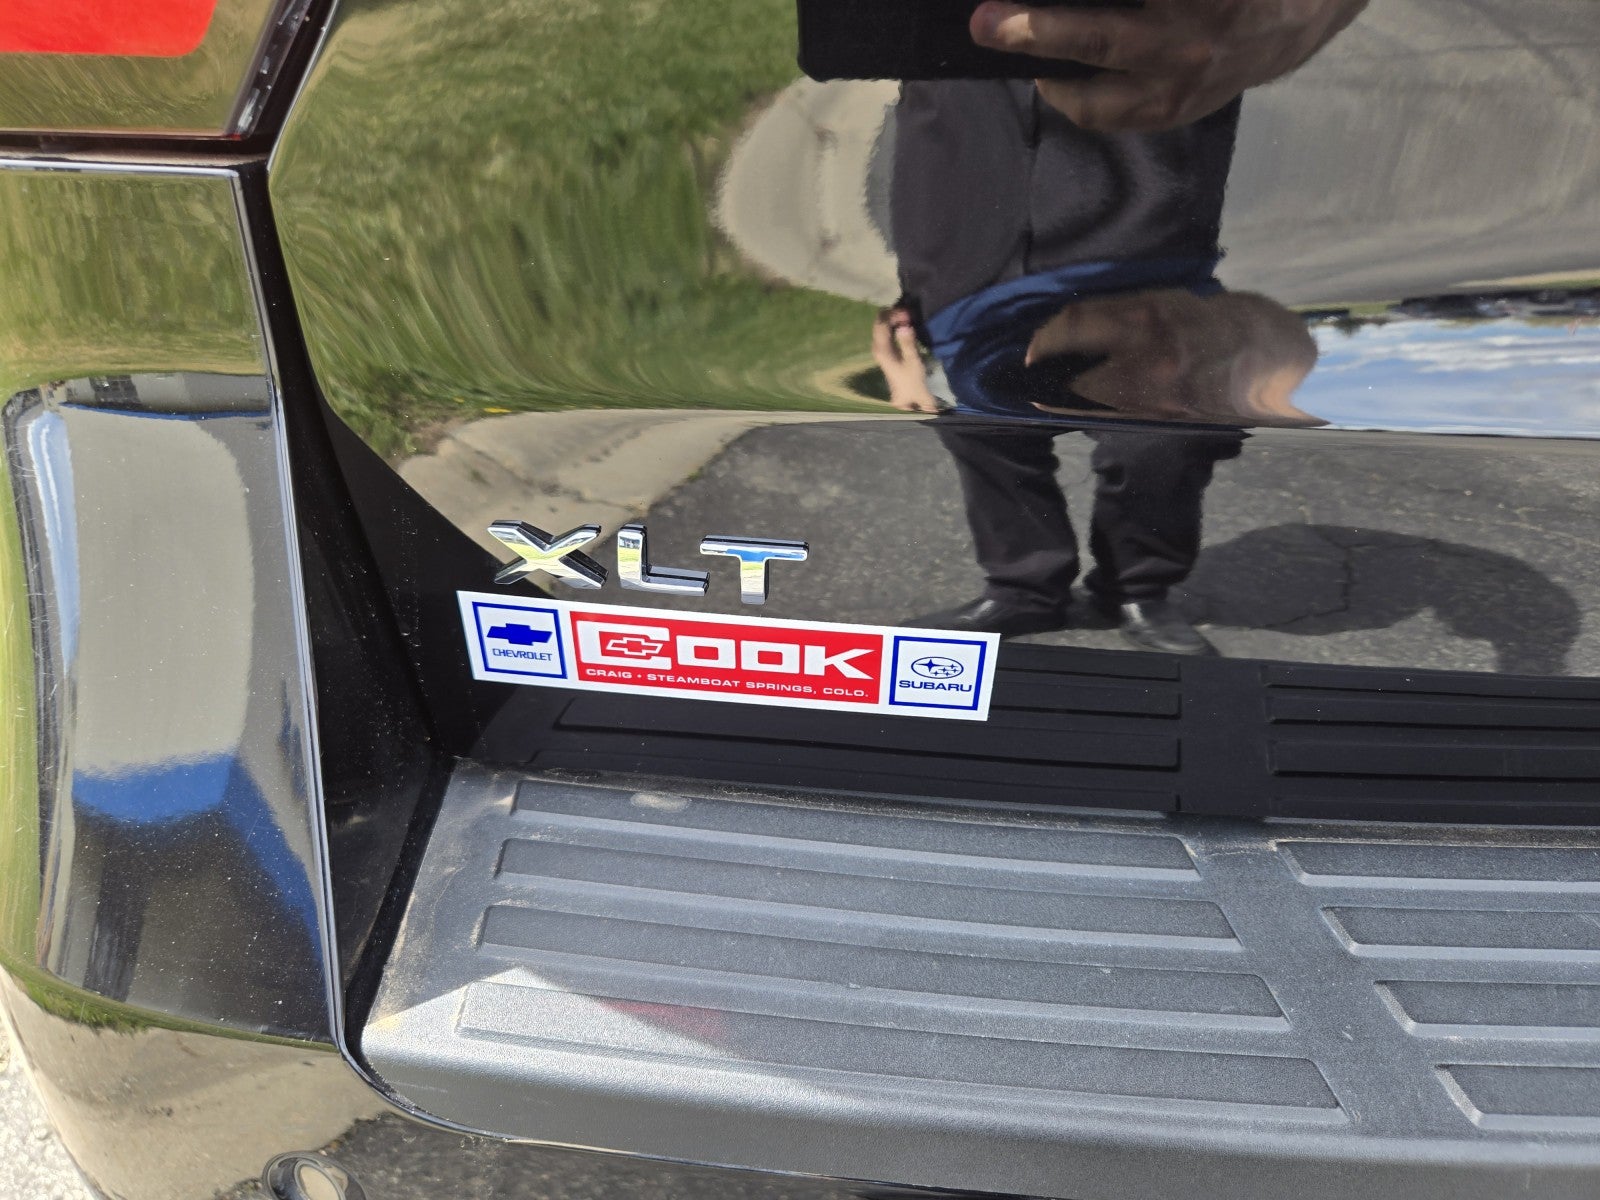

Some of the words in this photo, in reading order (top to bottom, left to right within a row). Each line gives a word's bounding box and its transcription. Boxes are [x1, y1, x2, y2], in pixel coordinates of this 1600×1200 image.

[487, 520, 809, 605] XLT
[492, 648, 553, 661] CHEVROLET
[576, 620, 875, 680] COOK
[585, 668, 632, 679] CRAIG
[647, 673, 740, 688] STEAMBOAT
[745, 681, 817, 694] SPRINGS,
[823, 687, 869, 697] COLO.
[898, 679, 973, 693] SUBARU
